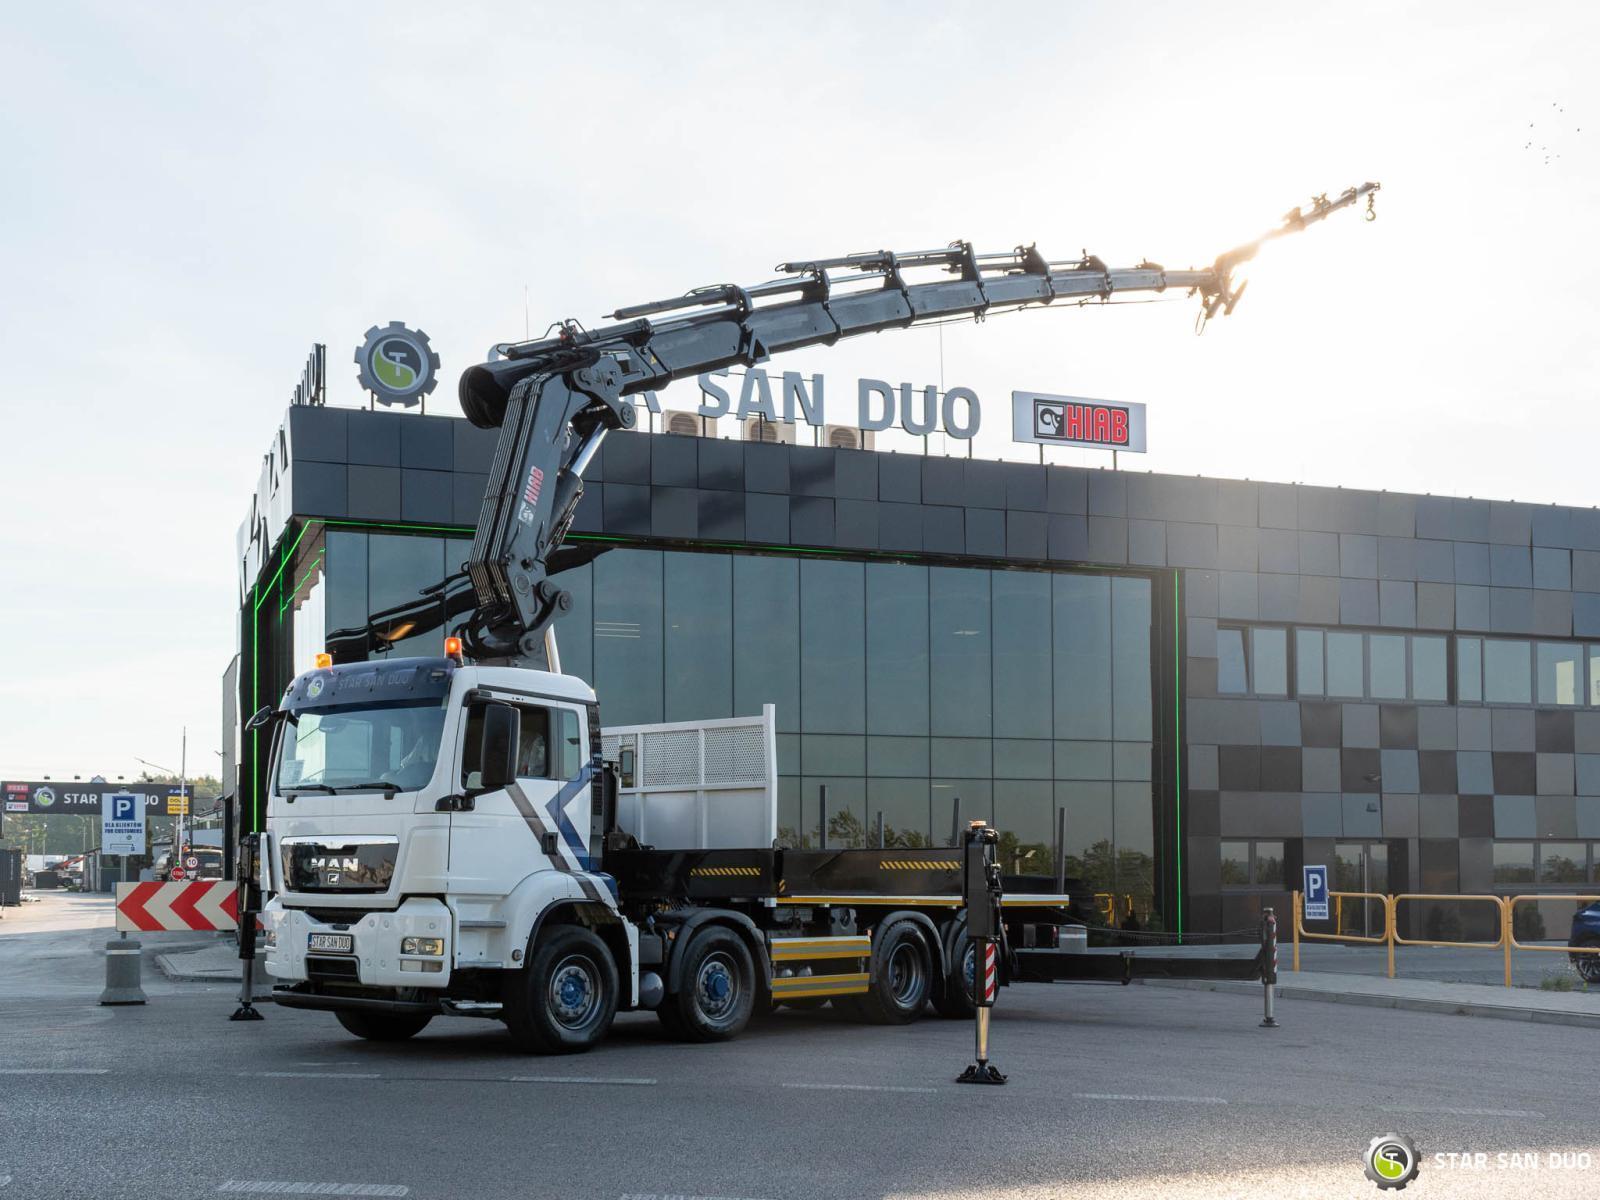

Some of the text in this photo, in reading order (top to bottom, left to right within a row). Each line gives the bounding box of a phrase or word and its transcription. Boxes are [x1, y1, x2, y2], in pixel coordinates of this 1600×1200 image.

[697, 367, 825, 427] SAN
[858, 378, 981, 440] DUO
[1066, 404, 1128, 444] HIAB
[523, 465, 544, 506] HIAB
[63, 793, 97, 804] STAR
[116, 800, 131, 817] P
[311, 858, 358, 872] MAN
[1308, 873, 1322, 898] P
[312, 935, 350, 949] STAR SAN DUO
